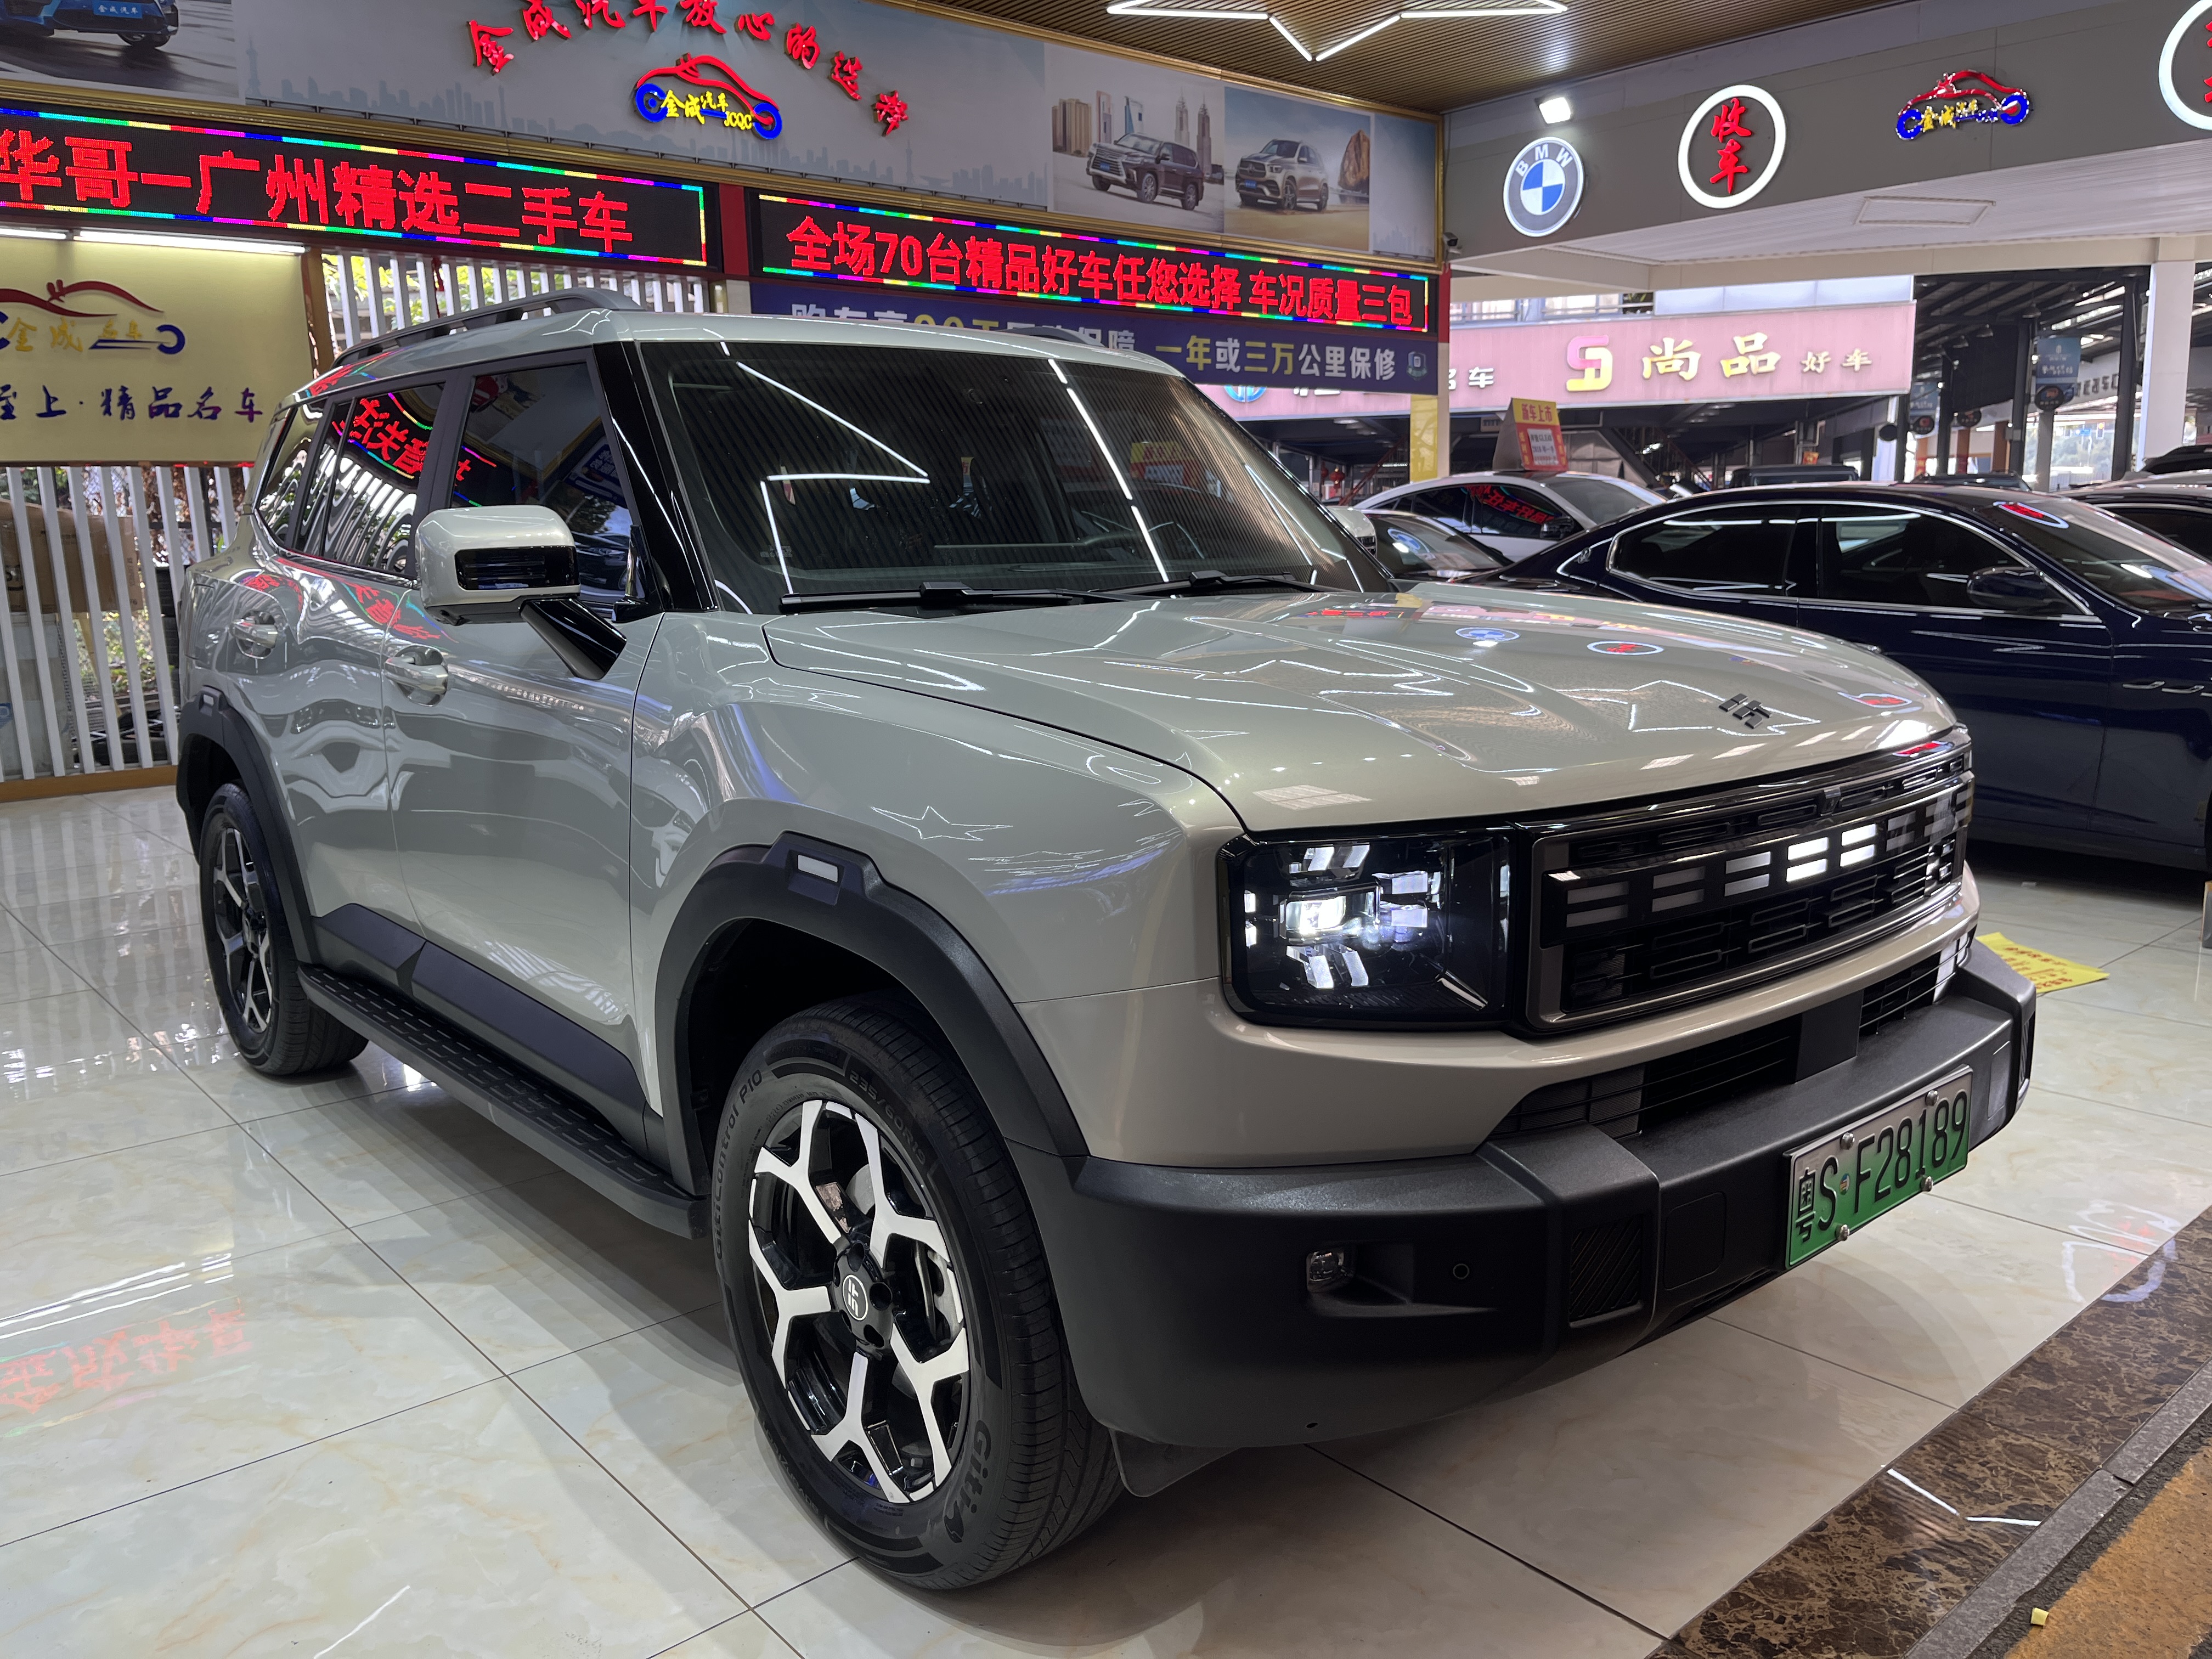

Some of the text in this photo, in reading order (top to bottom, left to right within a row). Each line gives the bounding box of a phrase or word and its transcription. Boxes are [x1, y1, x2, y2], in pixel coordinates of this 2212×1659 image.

[661, 90, 729, 124] 金成汽车
[724, 111, 752, 130] JCQC
[1710, 98, 1752, 193] 收车
[1515, 143, 1574, 176] BMW
[787, 215, 1413, 325] 全场70台精品好车任您选择 车况质量三包
[1155, 335, 1396, 381] 一年或三万公里保修
[849, 1069, 927, 1166] 235/60R19
[713, 1105, 740, 1261] GitiControl
[739, 1069, 763, 1104] P10
[960, 1420, 992, 1514] Giti
